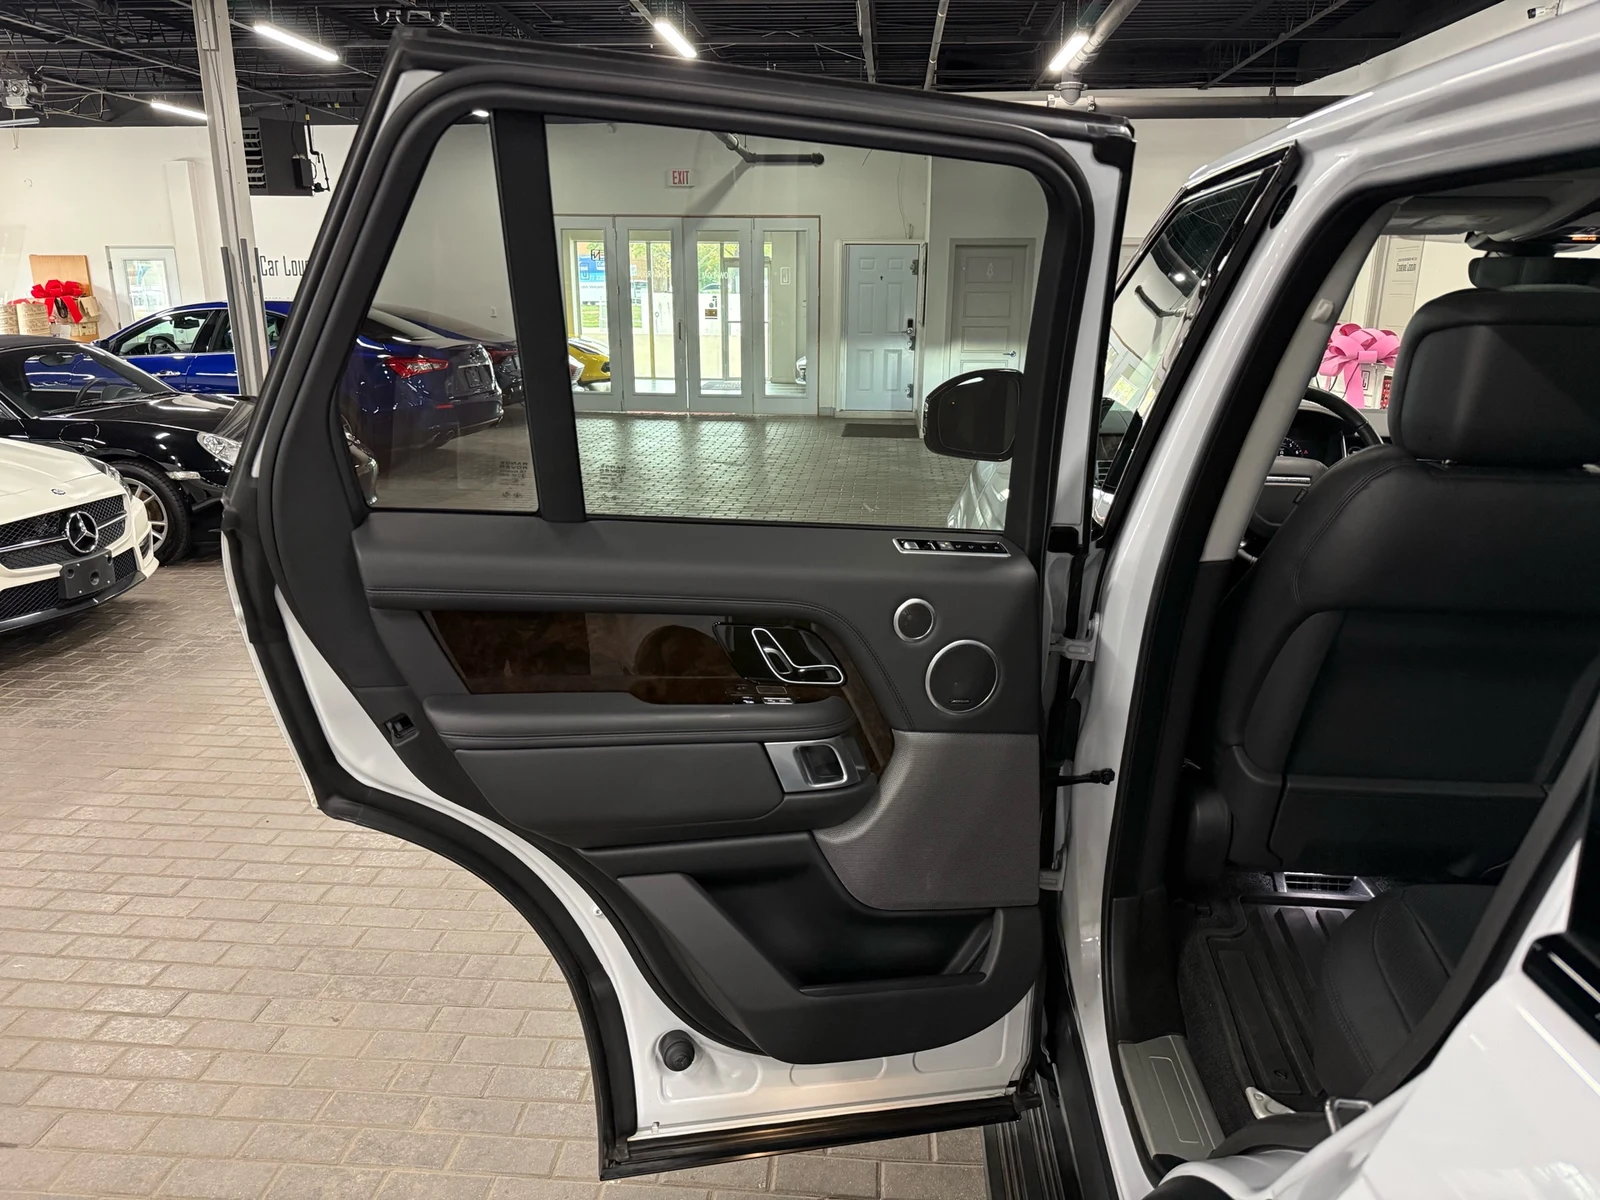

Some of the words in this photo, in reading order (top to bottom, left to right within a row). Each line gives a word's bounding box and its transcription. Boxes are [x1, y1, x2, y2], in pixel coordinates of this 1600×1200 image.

[672, 170, 690, 185] EXIT
[259, 255, 279, 277] Car
[282, 255, 309, 277] Lou
